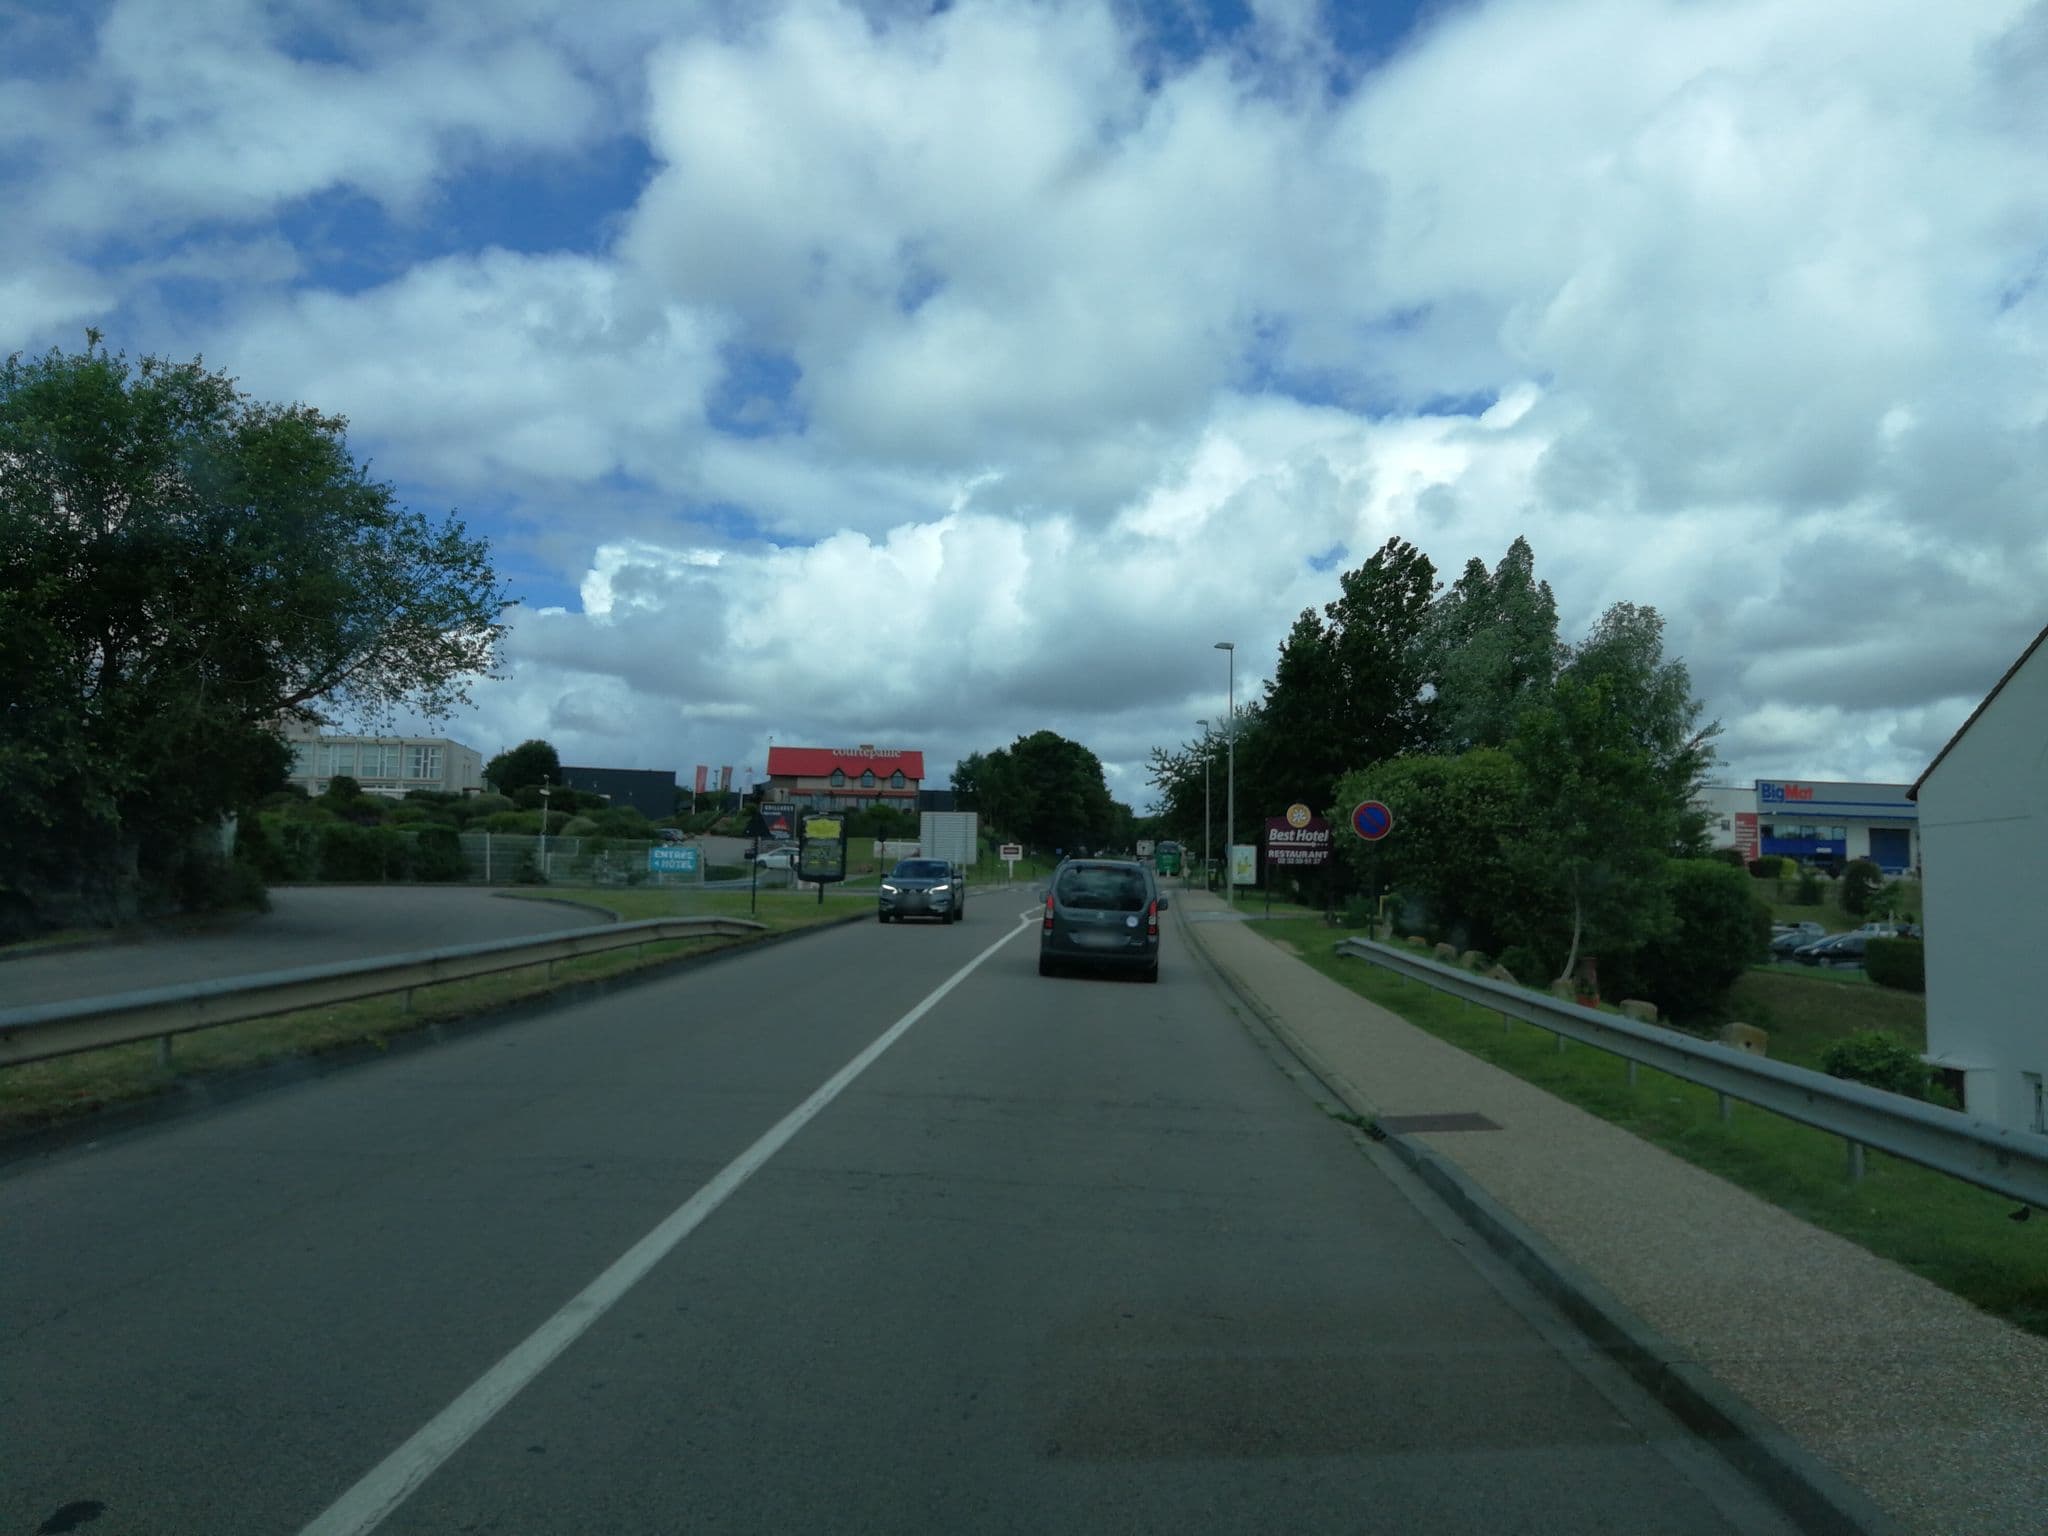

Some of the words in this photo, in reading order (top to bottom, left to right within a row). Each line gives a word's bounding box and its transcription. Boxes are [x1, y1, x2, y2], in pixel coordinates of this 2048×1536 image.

[1761, 783, 1813, 802] BigMat
[1269, 829, 1295, 841] Best
[1296, 829, 1329, 842] Hotel
[1268, 850, 1328, 858] RESTAURANT
